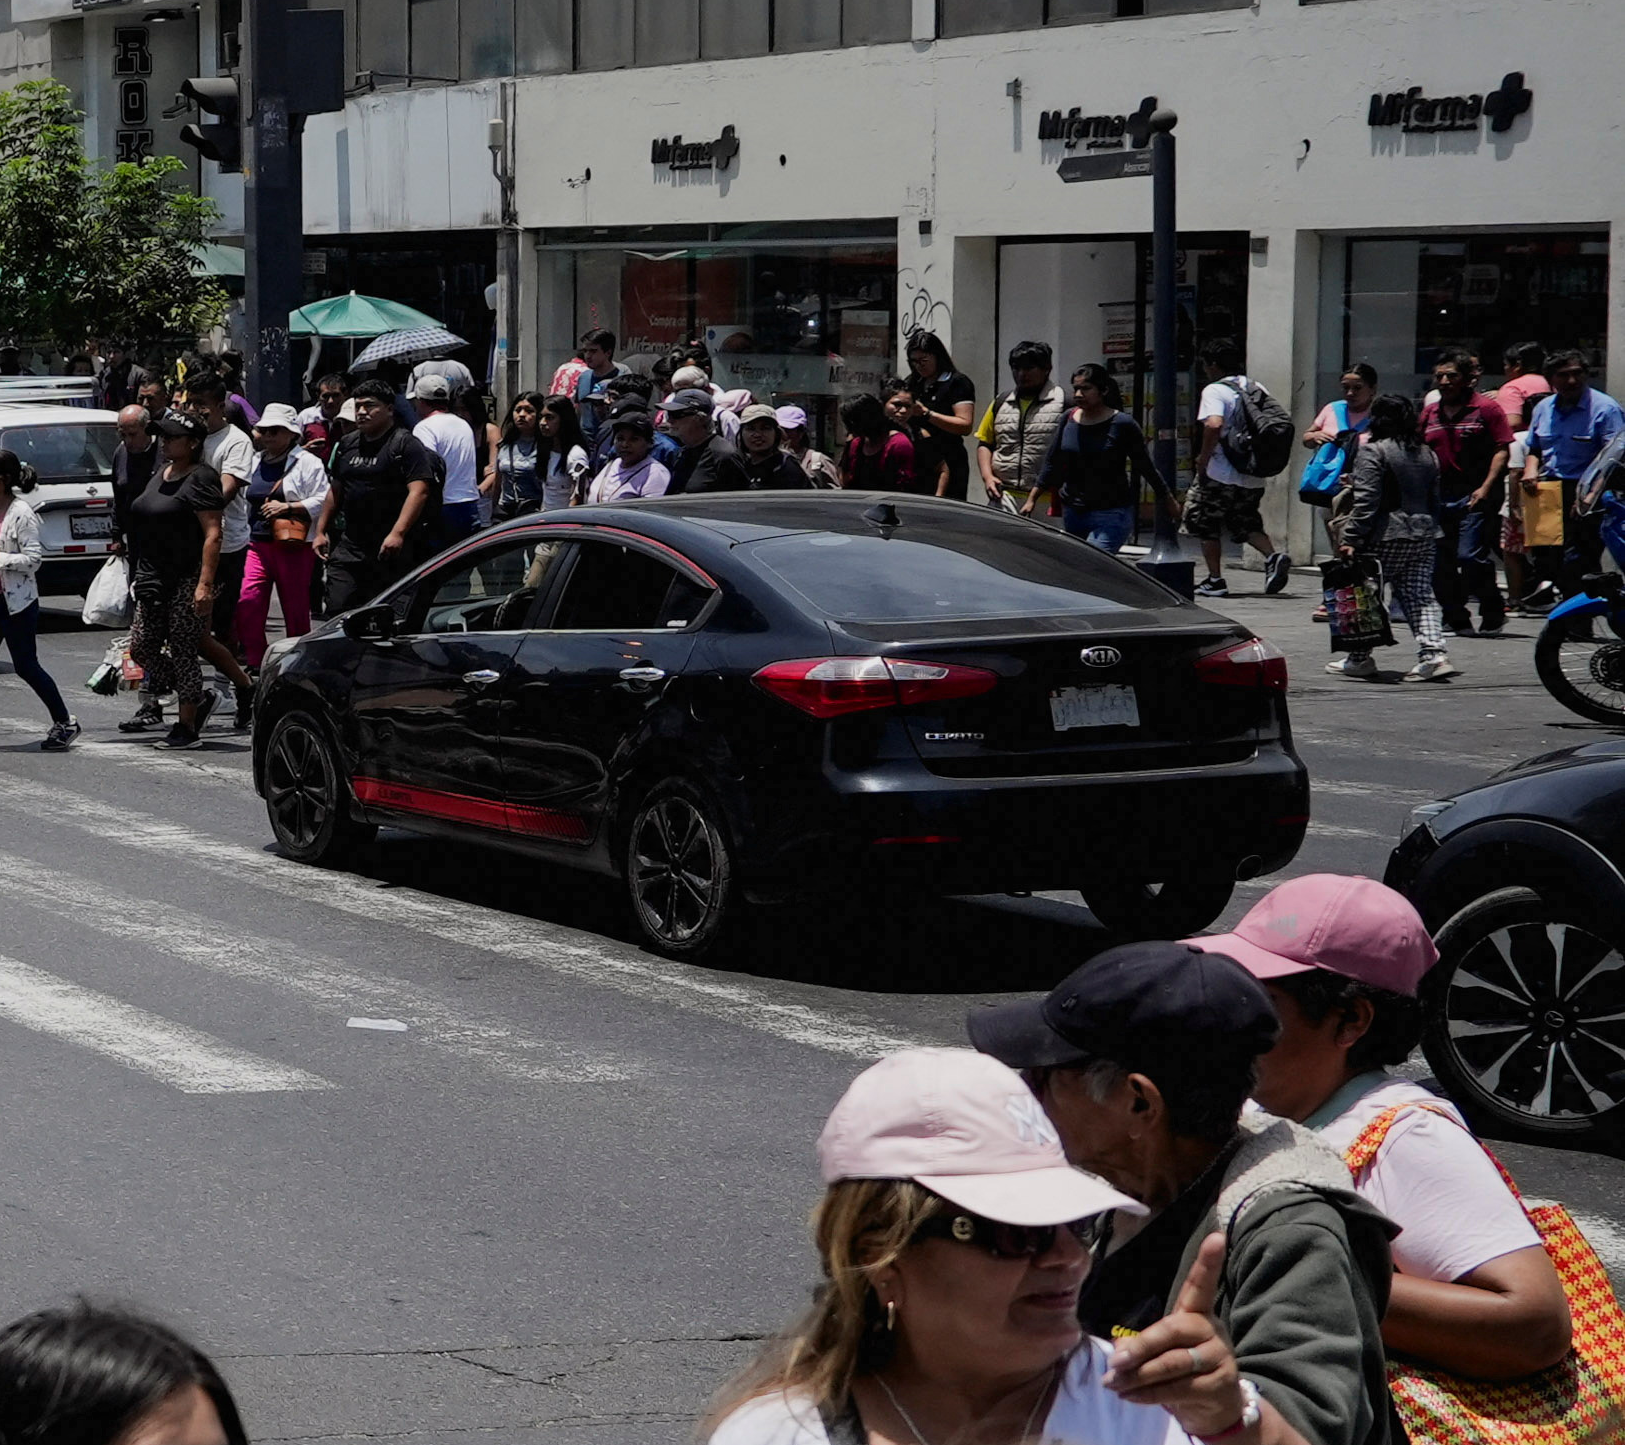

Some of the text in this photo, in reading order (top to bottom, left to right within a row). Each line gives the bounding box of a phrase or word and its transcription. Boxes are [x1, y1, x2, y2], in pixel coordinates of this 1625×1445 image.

[1368, 86, 1483, 126] Mifarma
[1039, 106, 1126, 140] Mifarma
[650, 134, 713, 164] Mifarma
[1089, 649, 1117, 663] KIA
[924, 732, 985, 741] CERATO
